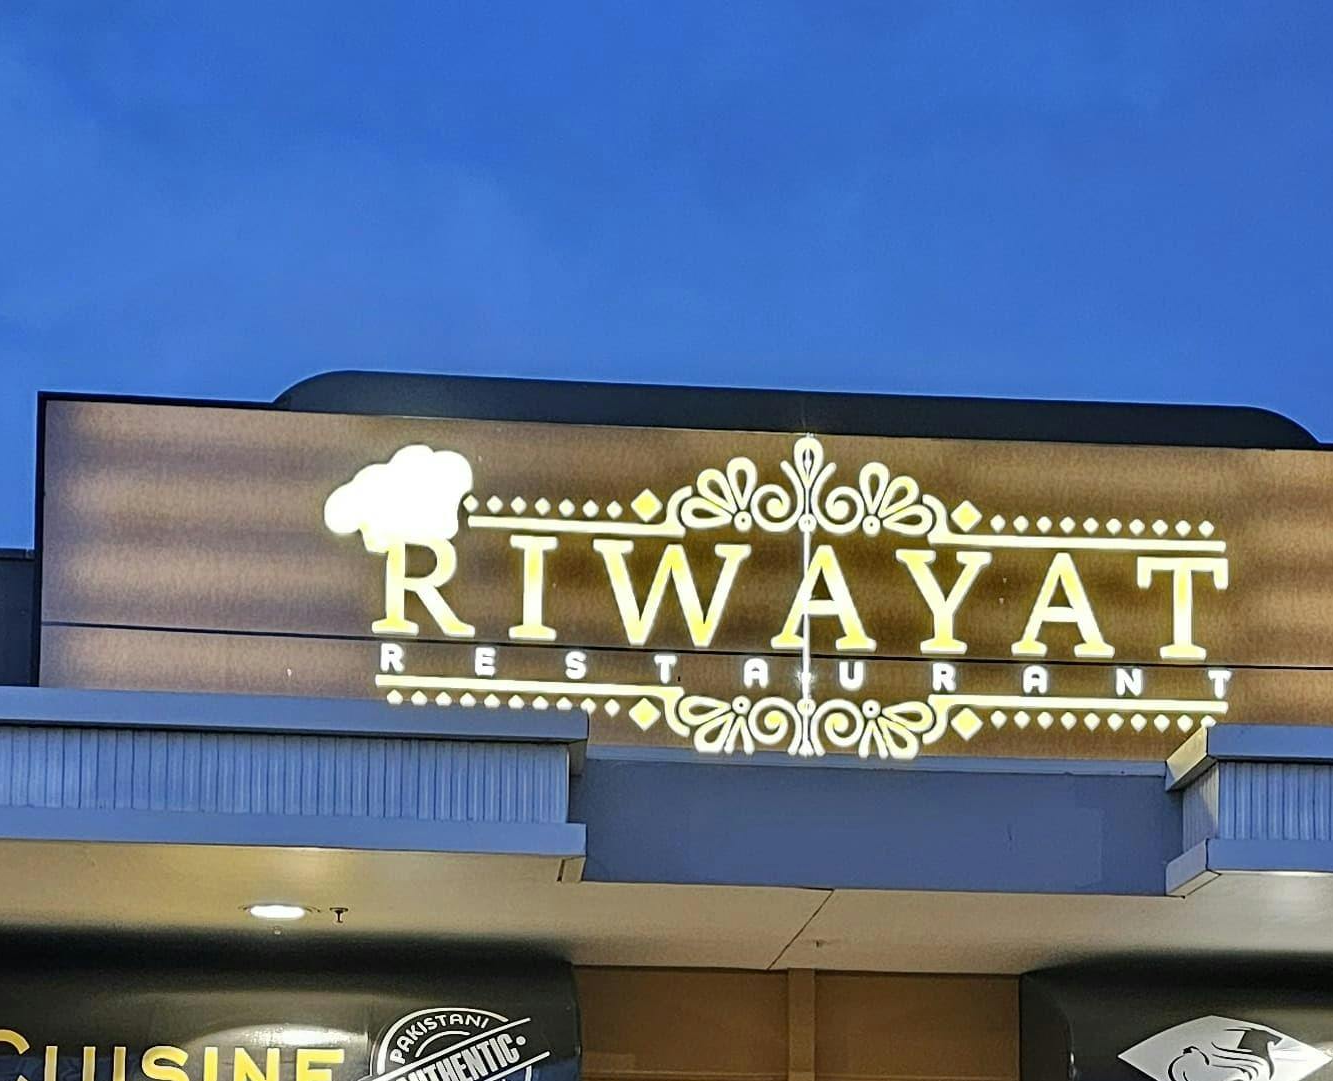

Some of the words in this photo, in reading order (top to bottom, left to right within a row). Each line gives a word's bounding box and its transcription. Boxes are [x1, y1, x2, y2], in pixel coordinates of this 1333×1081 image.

[371, 534, 1228, 660] RIWAYAT
[381, 643, 1232, 696] RESTAURANT
[389, 1013, 489, 1065] PAKISTANI
